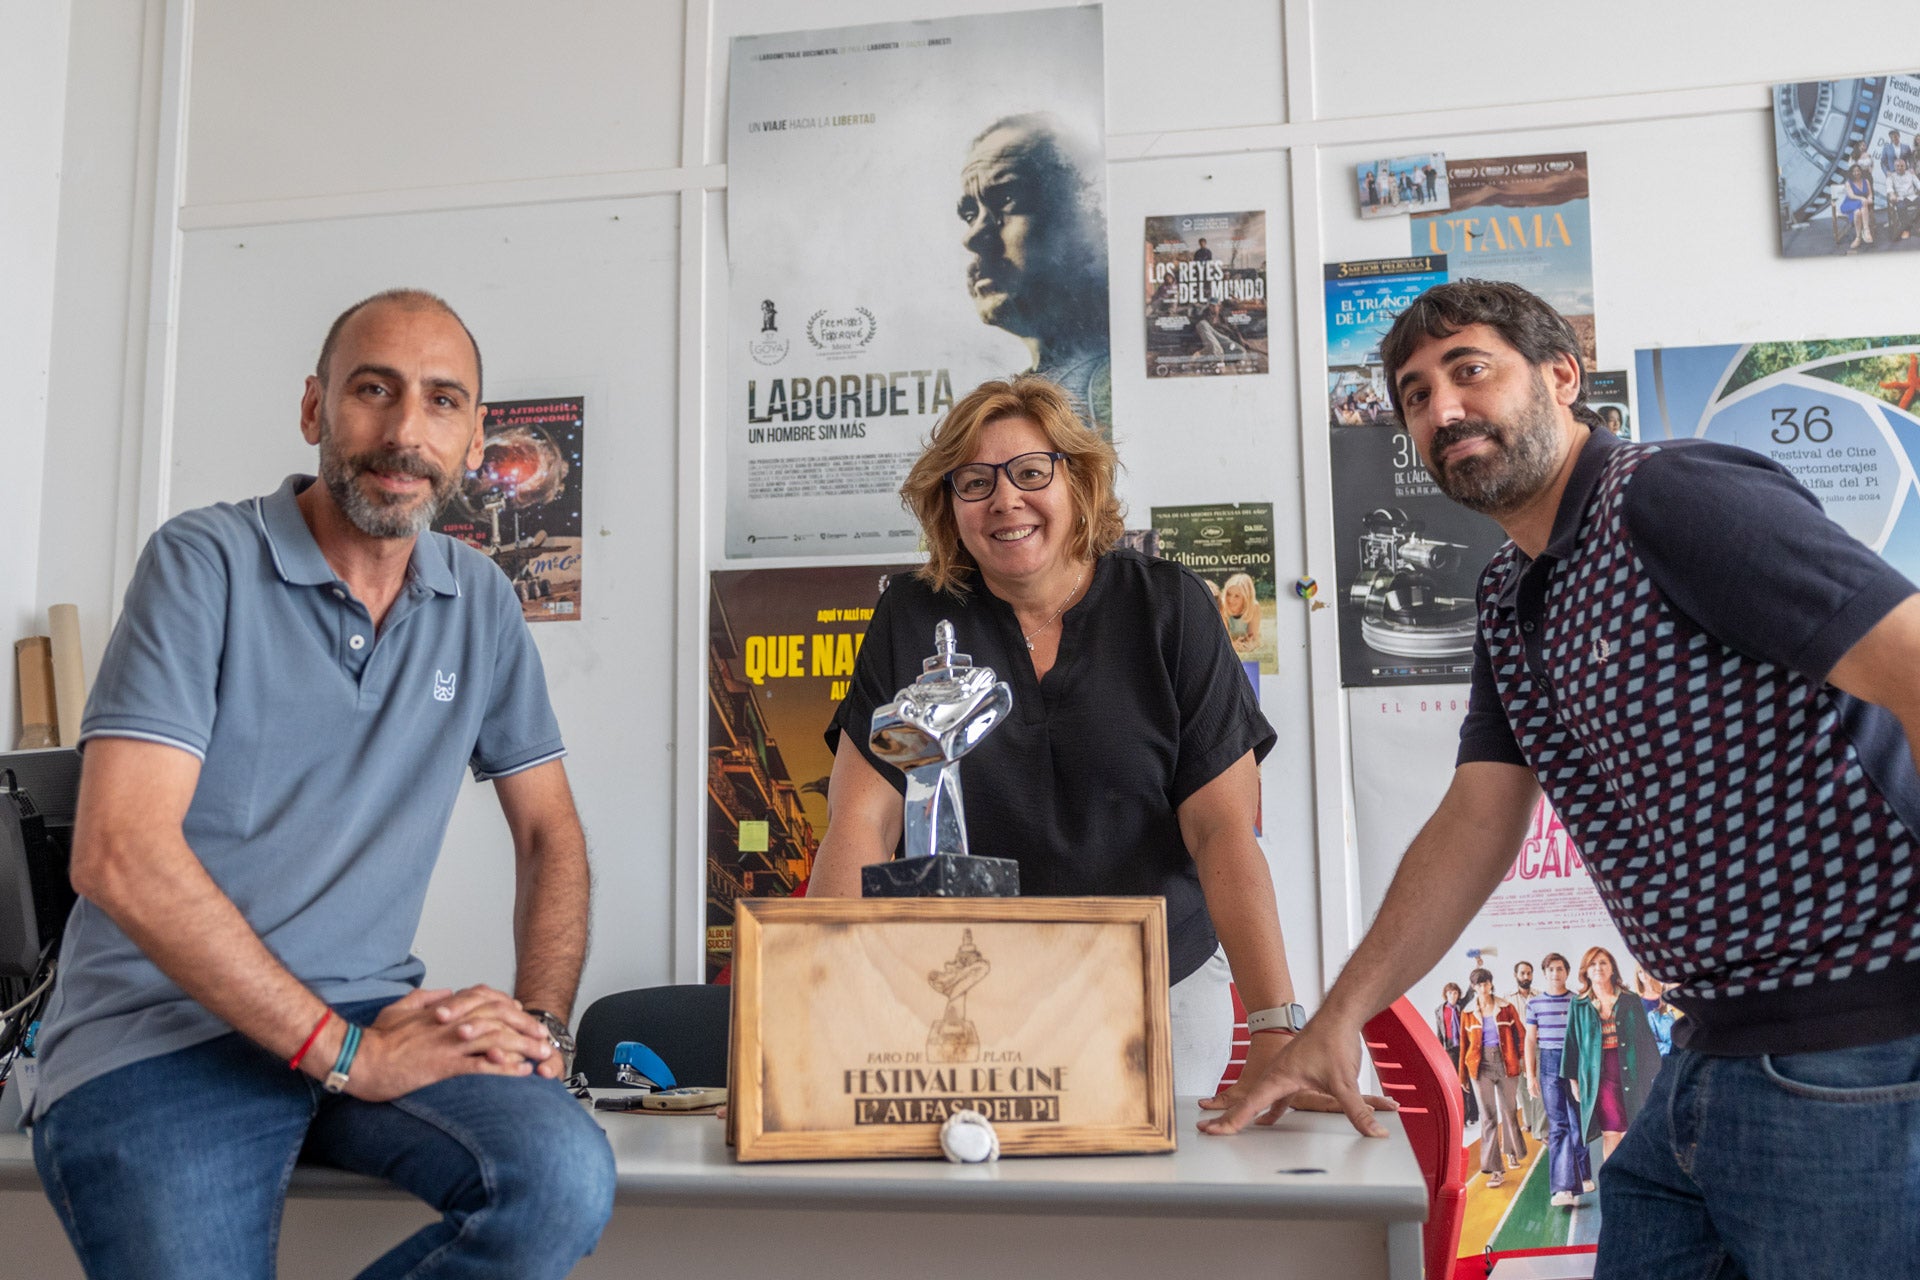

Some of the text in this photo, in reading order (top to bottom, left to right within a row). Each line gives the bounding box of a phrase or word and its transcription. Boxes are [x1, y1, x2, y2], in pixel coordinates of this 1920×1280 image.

[749, 113, 876, 133] UN VIAJE HACIA LA LIBERTAD
[1883, 109, 1893, 121] de
[1428, 212, 1571, 254] UTAMA
[1148, 260, 1224, 283] LOS REYES
[1337, 262, 1349, 278] 3
[1179, 278, 1264, 304] DEL MUNDO
[1341, 299, 1356, 312] EL
[1336, 312, 1354, 326] DE
[1356, 311, 1374, 325] LA
[748, 368, 955, 424] LABORDETA
[748, 420, 866, 444] UN HOMBRE SIN MÁS
[1770, 405, 1834, 444] 36
[1770, 446, 1877, 460] Festival de Cine
[1395, 472, 1405, 484] DE
[1839, 477, 1859, 488] del
[1865, 476, 1879, 487] Pi
[1858, 493, 1880, 501] 2024
[1221, 552, 1271, 565] verano
[817, 608, 836, 623] AQUÍ
[837, 610, 843, 621] Y
[843, 607, 859, 621] ALLÍ
[745, 634, 805, 685] QUE
[1382, 702, 1401, 713] EL
[867, 1051, 922, 1064] FARO DE
[983, 1051, 1022, 1064] PLATA
[844, 1065, 1069, 1094] FESTIVAL DE CINE
[972, 1099, 1024, 1121] DEL
[1030, 1098, 1055, 1121] PI
